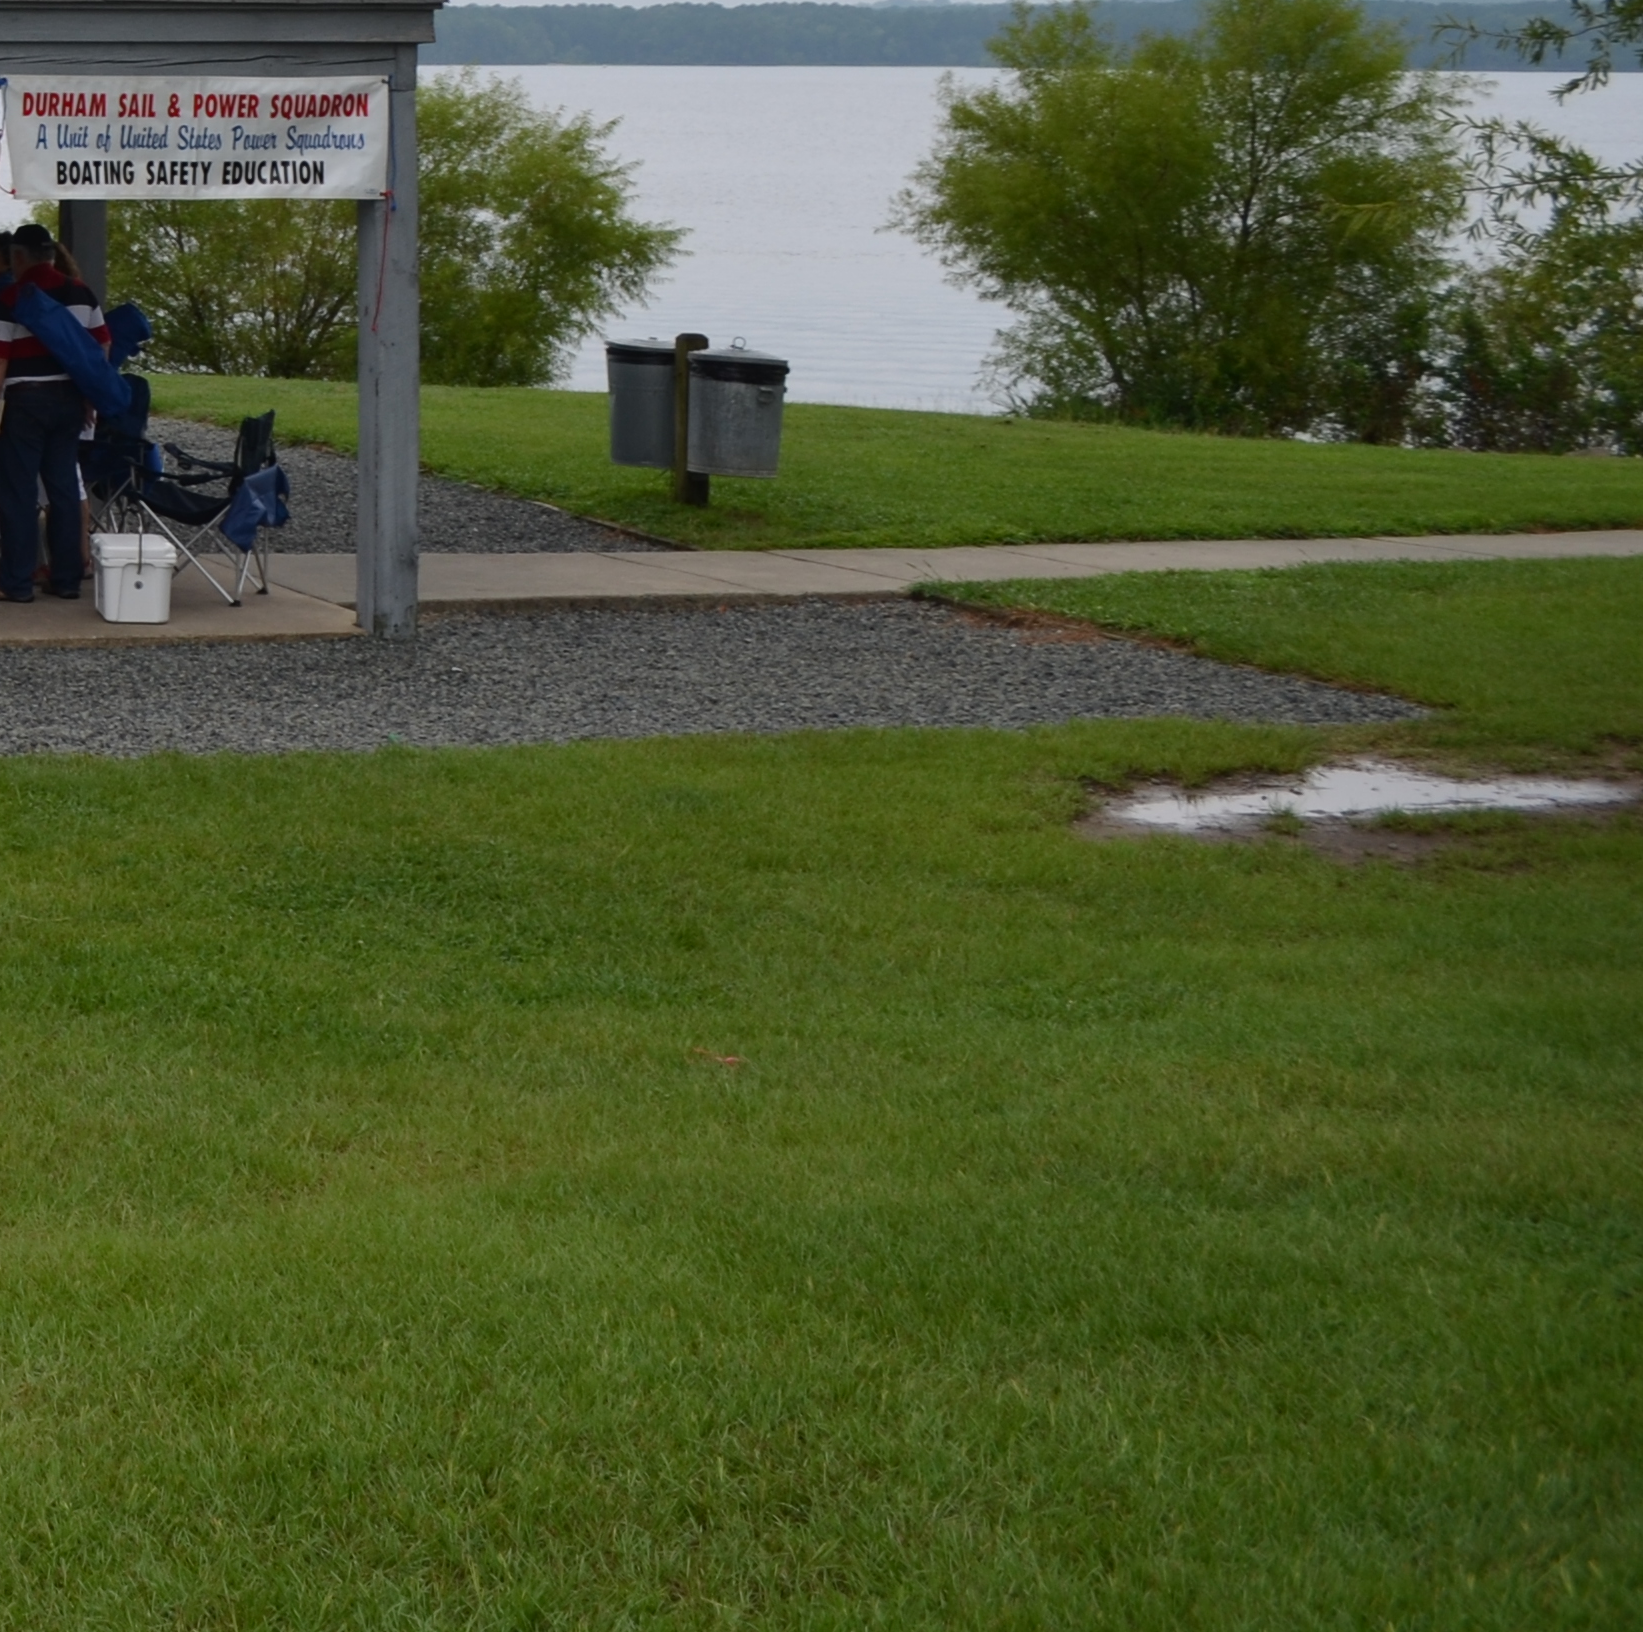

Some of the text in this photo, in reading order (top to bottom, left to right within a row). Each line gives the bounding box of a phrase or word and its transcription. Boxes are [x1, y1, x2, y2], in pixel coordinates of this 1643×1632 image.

[22, 92, 369, 120] DURHAM SAIL & POWER SQUADRON
[35, 123, 365, 155] A Unit of United States Power Squadrons
[56, 160, 325, 186] BOATING SAFETY EDUCATION
